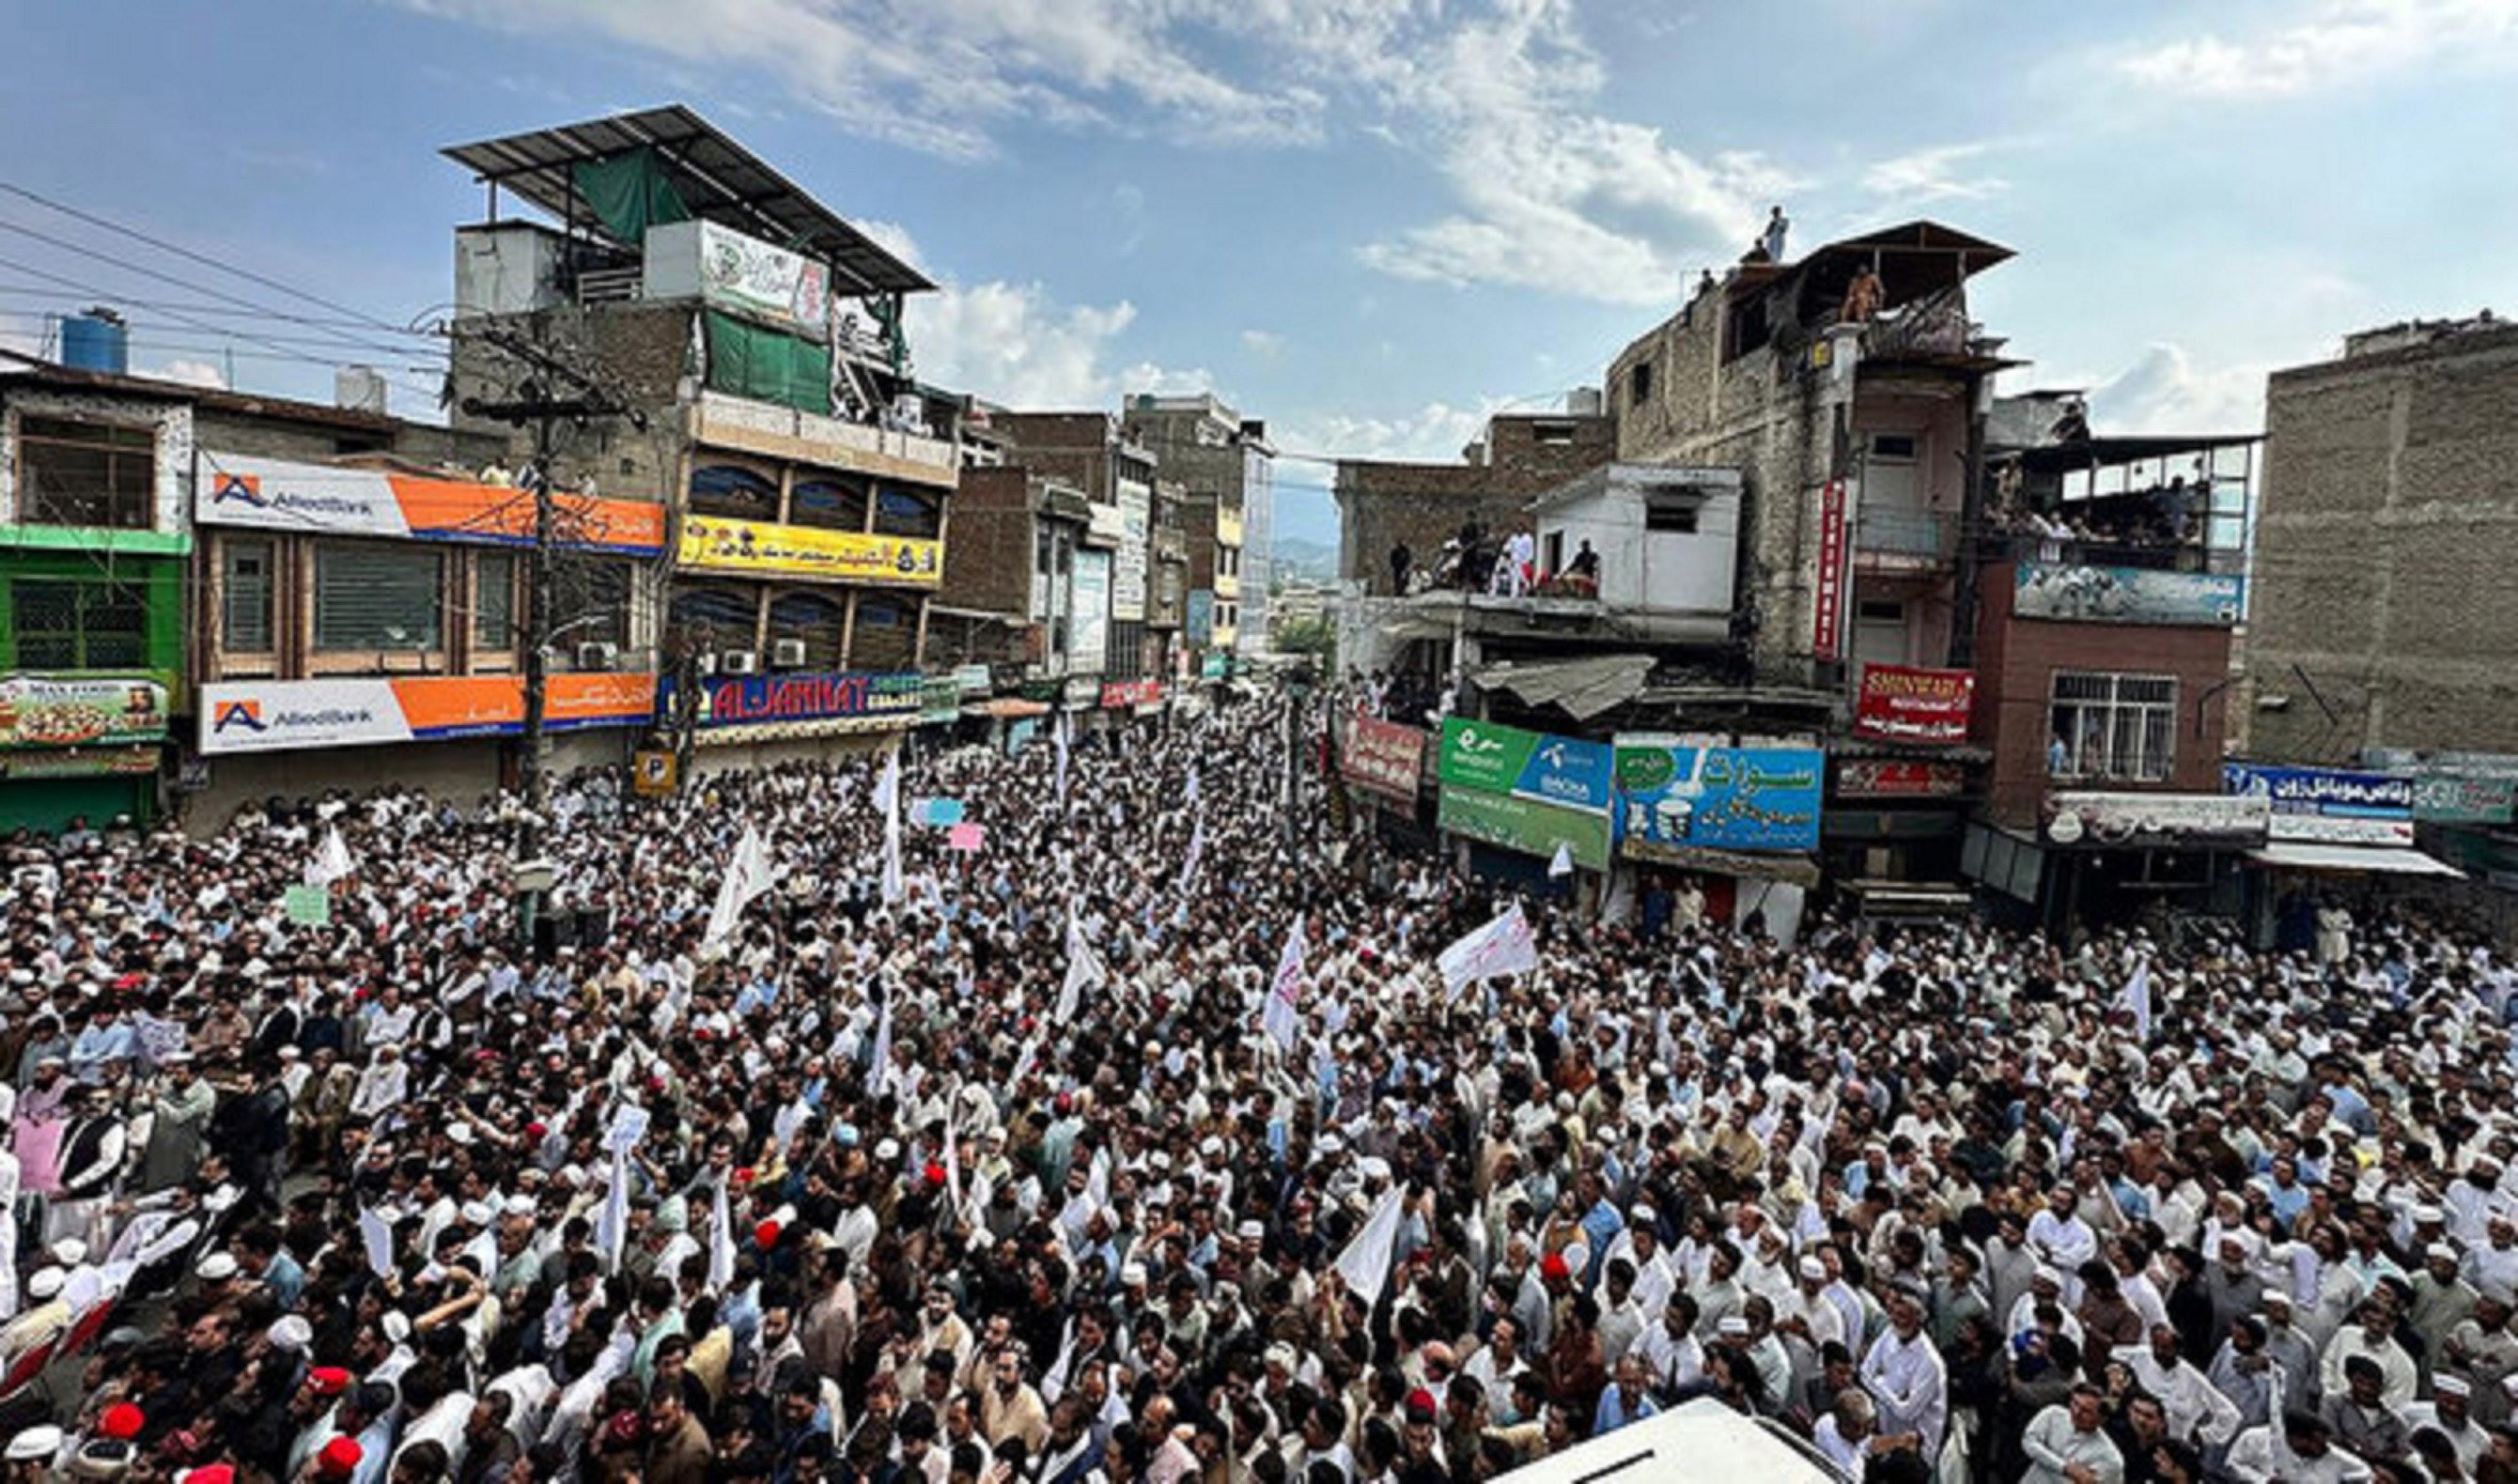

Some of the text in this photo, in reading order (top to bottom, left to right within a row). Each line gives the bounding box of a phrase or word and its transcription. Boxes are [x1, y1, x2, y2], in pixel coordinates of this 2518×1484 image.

[272, 490, 374, 517] AlliedBank
[273, 709, 373, 727] AlliedBank
[649, 758, 663, 778] P
